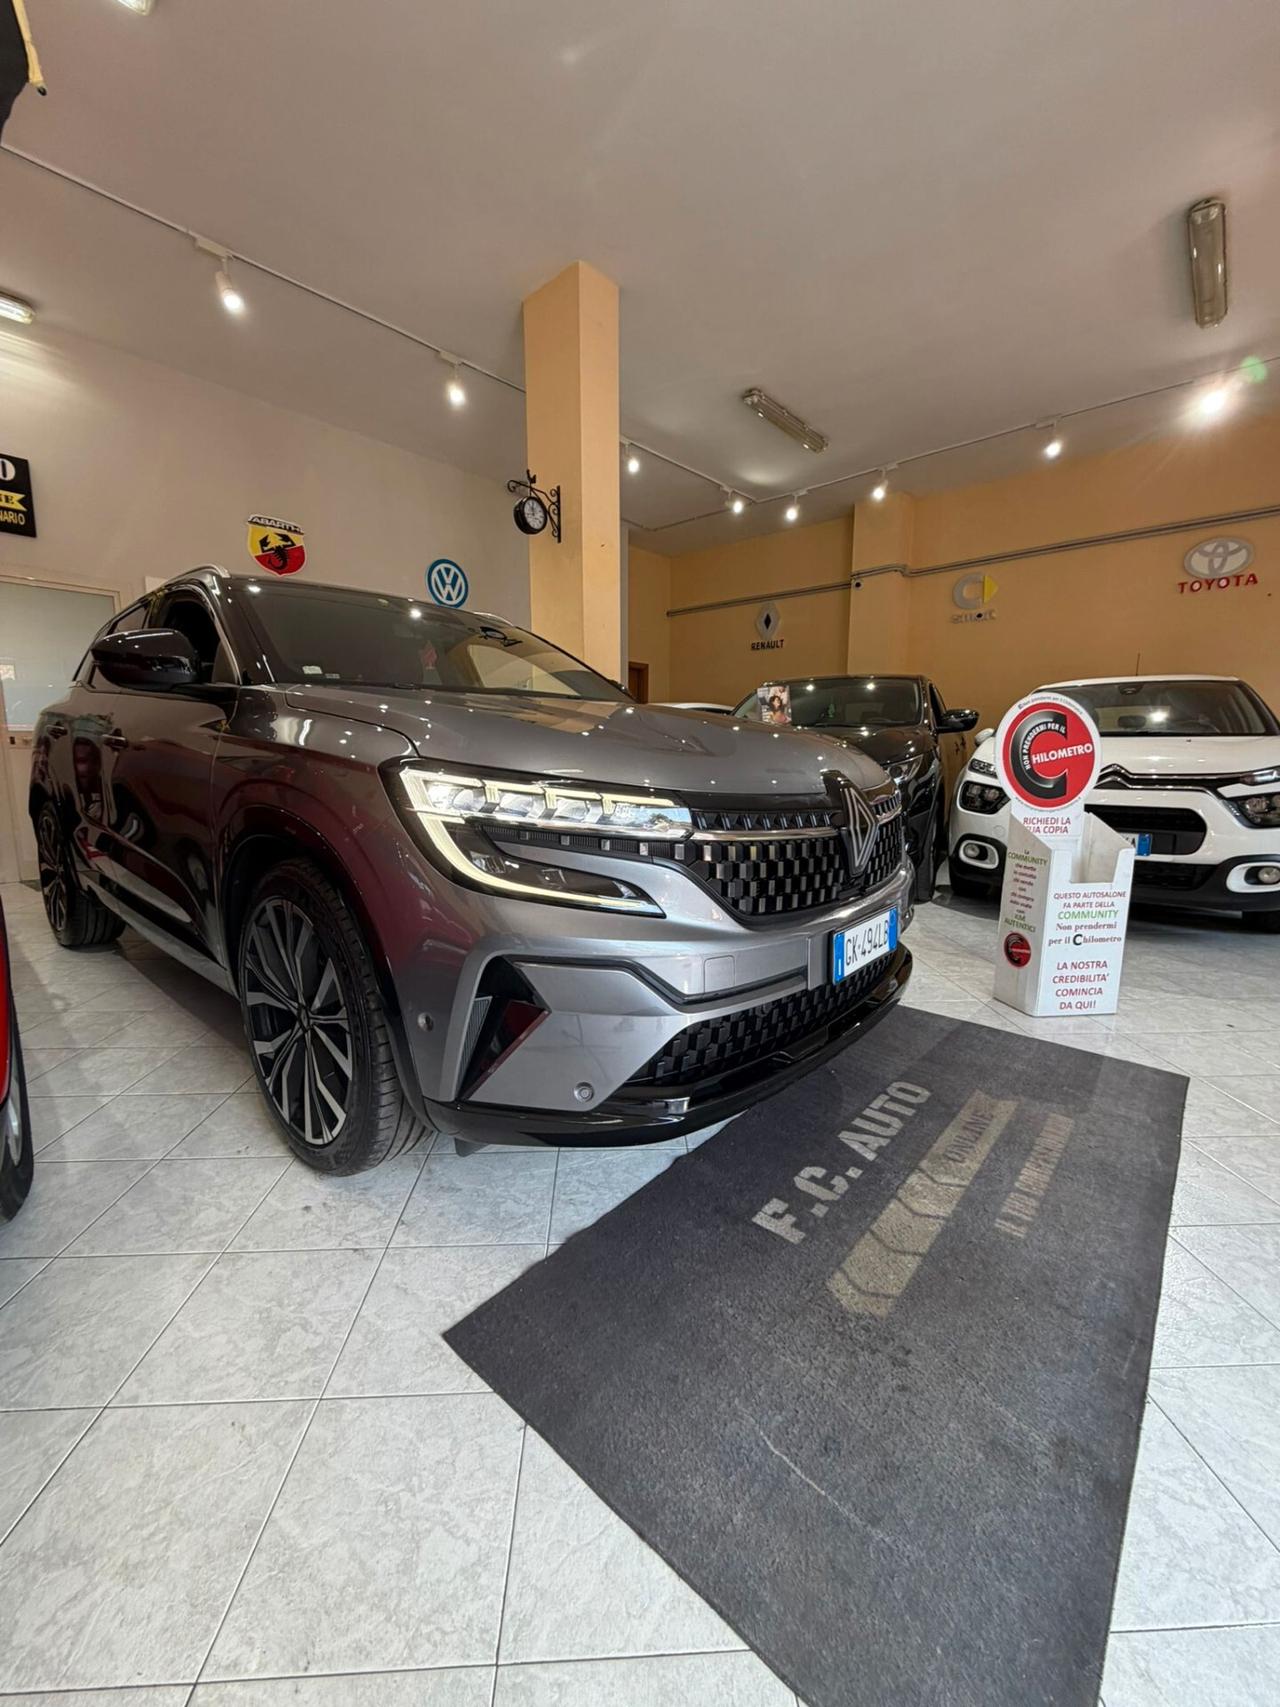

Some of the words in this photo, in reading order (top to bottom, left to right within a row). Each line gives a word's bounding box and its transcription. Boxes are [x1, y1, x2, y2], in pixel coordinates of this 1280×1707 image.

[251, 516, 303, 534] ABARTH
[1178, 573, 1258, 594] TOYOTA
[751, 639, 784, 650] RENAULT
[1023, 817, 1059, 825] RICHIEDI
[1061, 817, 1071, 825] LA
[1043, 825, 1069, 833] COPIA
[1008, 852, 1048, 865] COMMUNITY
[1082, 891, 1127, 899] AUTOSALONE
[1058, 910, 1119, 920] COMMUNITY
[1056, 923, 1072, 931] Non
[1075, 921, 1117, 932] prendermi
[1048, 938, 1062, 946] per
[1065, 936, 1070, 944] il
[1057, 962, 1068, 970] LA
[1071, 960, 1108, 970] NOSTRA
[1052, 974, 1109, 984] CREDIBILITA'
[1055, 987, 1103, 997] COMINCIA
[1060, 1001, 1072, 1010] DA
[1075, 1000, 1096, 1010] QUI!
[751, 1166, 863, 1244] F.C.
[838, 1081, 931, 1162] AUTO
